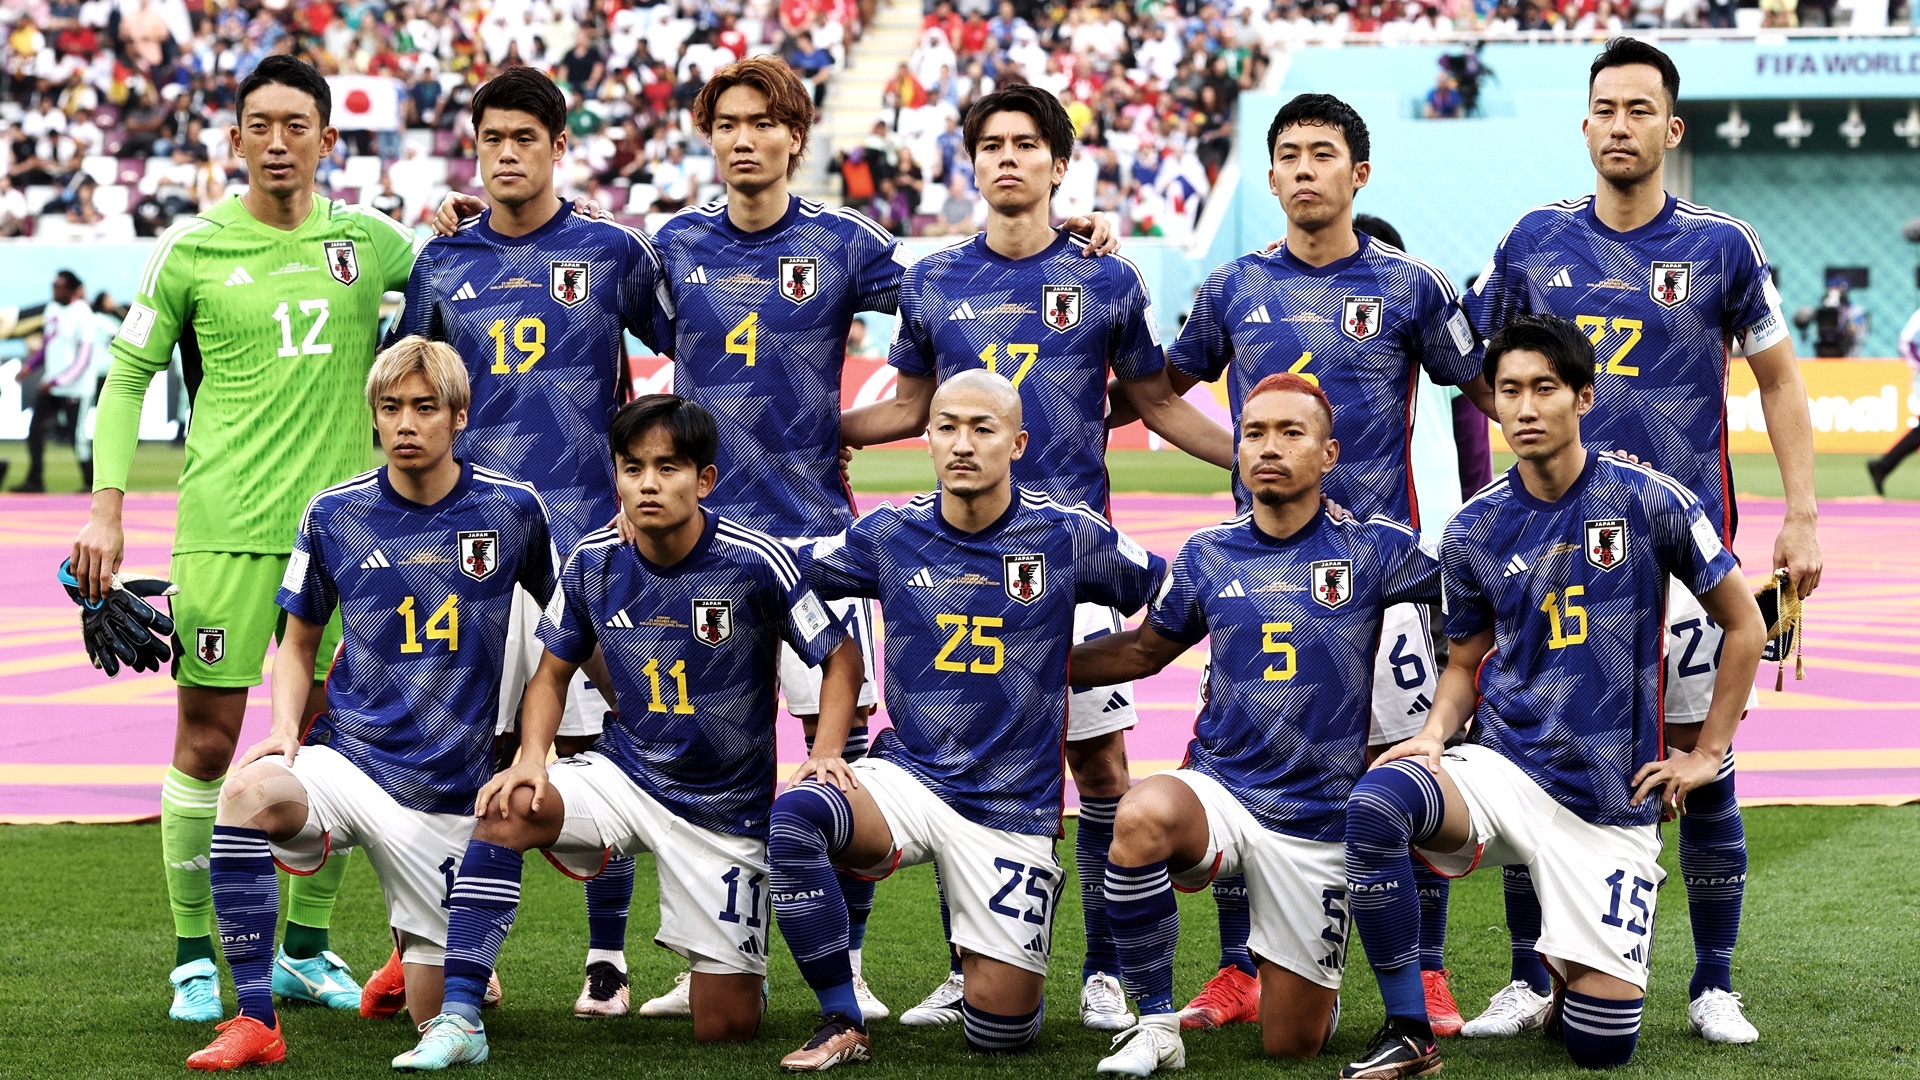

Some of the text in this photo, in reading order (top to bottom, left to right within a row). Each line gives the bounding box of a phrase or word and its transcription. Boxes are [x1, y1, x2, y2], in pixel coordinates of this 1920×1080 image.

[1756, 53, 1816, 74] FIFA
[272, 298, 333, 358] 12
[487, 317, 546, 375] 19
[725, 311, 758, 367] 4
[1751, 315, 1777, 335] UNITES
[978, 343, 1039, 391] 17
[396, 593, 459, 653] 14
[934, 613, 1005, 674] 25
[1540, 585, 1588, 650] 15
[1261, 622, 1297, 682] 5
[1389, 633, 1427, 690] 6
[641, 658, 696, 715] 11
[719, 866, 765, 929] 11
[770, 888, 825, 902] APAN
[989, 856, 1054, 926] 25
[1321, 889, 1346, 944] 5
[1601, 868, 1655, 937] 15
